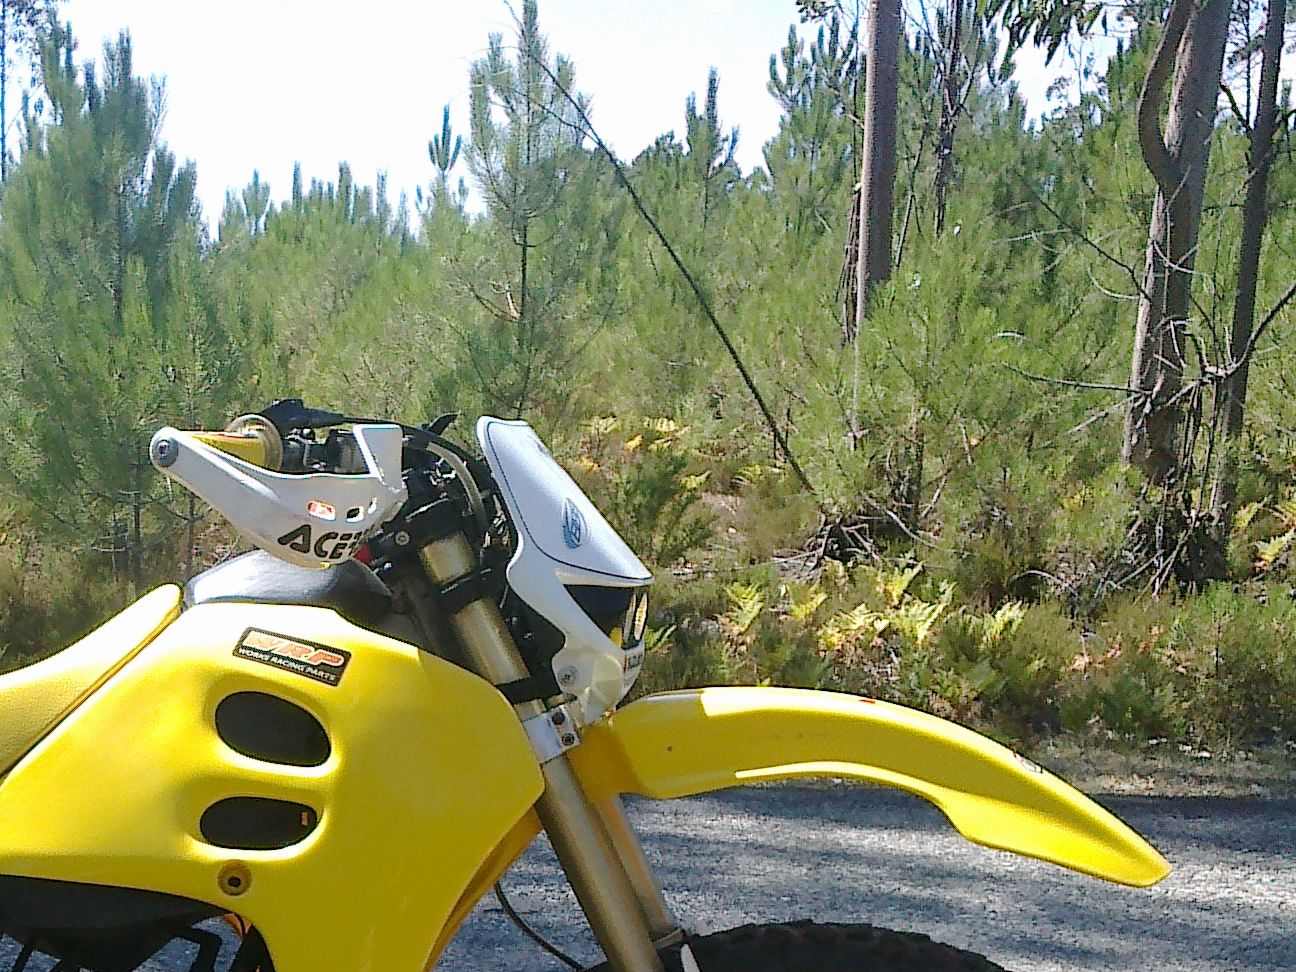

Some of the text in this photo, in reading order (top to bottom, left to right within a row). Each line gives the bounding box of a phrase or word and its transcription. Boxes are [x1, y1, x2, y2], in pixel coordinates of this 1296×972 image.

[238, 648, 336, 681] WORKS RACING PARTS
[241, 632, 344, 665] WRP
